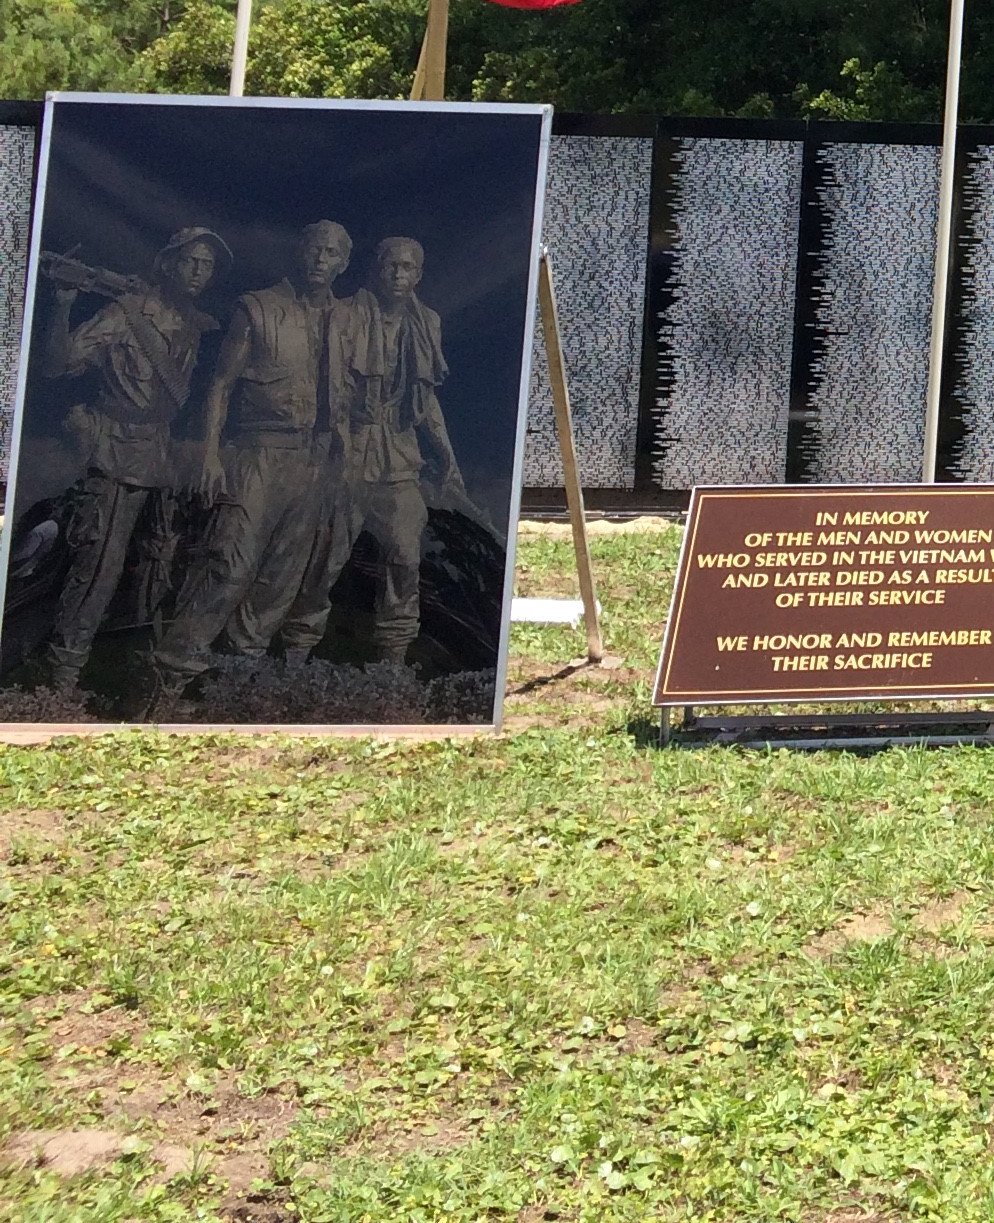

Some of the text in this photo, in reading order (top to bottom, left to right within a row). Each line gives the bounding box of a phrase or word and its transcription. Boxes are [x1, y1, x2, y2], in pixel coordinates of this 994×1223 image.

[815, 510, 930, 526] IN MEMORY
[744, 529, 993, 548] OF THE MEN AND WOMEN
[697, 553, 751, 569] WHO
[754, 551, 828, 567] SERVED
[832, 551, 856, 566] IN
[858, 549, 897, 565] THE
[898, 548, 986, 564] VIETNAM
[721, 573, 770, 589] AND
[773, 571, 832, 587] LATER
[835, 571, 886, 586] DIED
[887, 570, 913, 585] AS
[914, 569, 930, 584] A
[775, 589, 946, 608] OF THEIR SERVICE
[716, 629, 993, 652] WE HONOR AND REMEMBER
[771, 652, 933, 671] THEIR SACRIFICE
